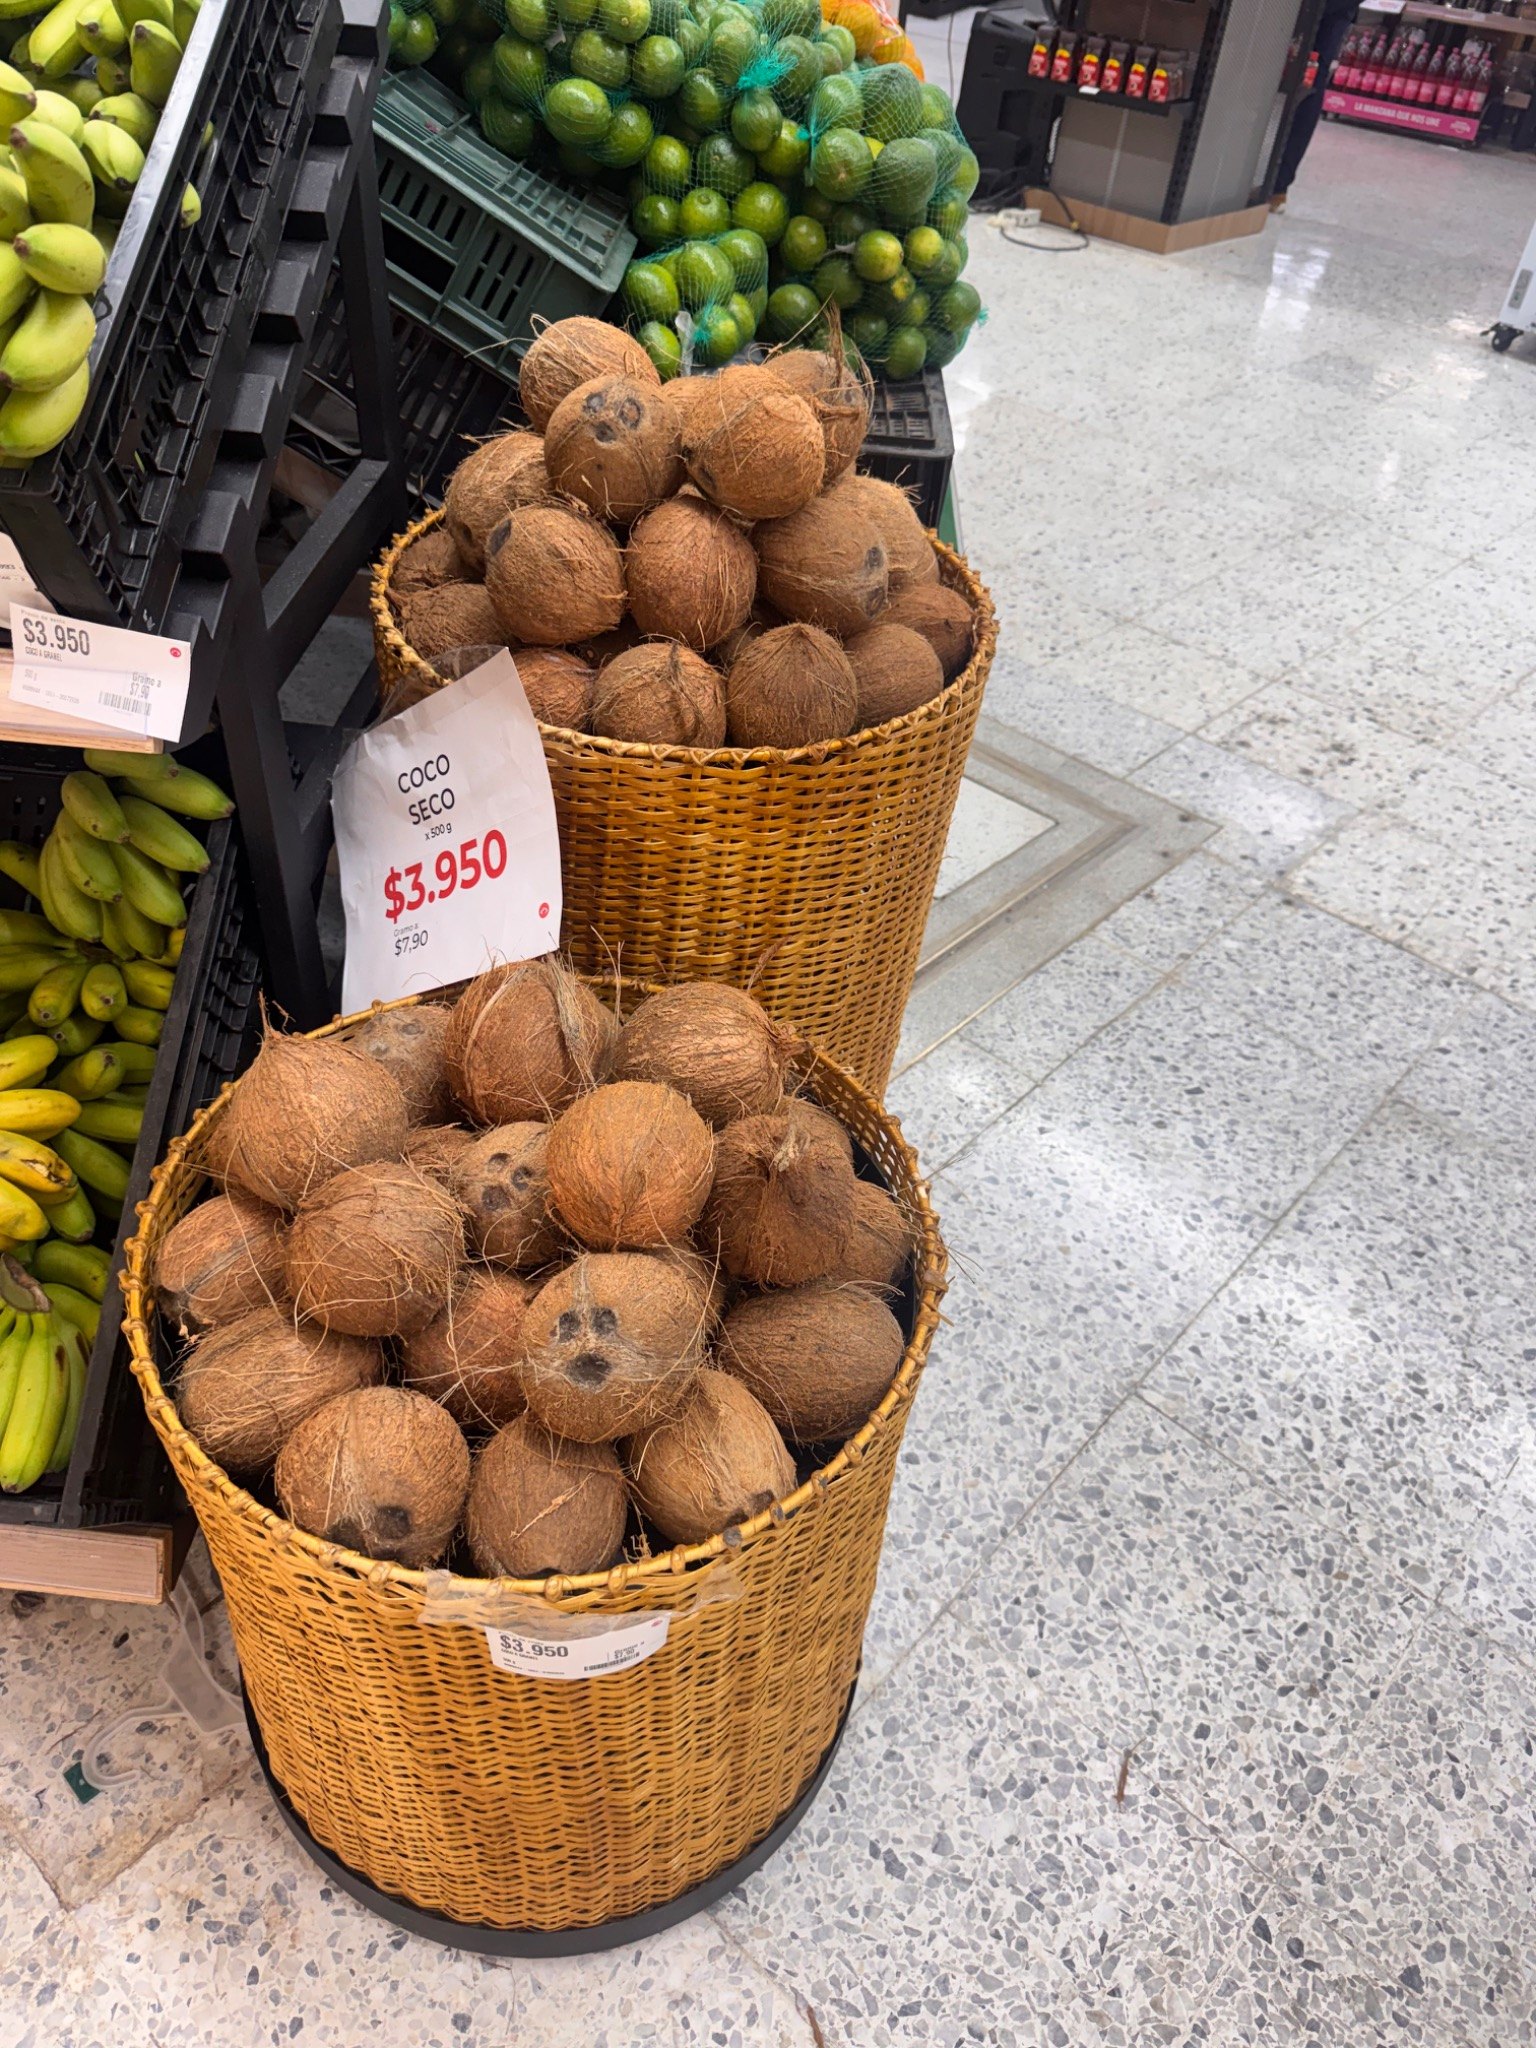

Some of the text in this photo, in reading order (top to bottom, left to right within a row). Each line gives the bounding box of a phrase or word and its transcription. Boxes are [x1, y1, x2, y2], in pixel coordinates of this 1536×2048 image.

[22, 617, 90, 656] $3.950
[398, 754, 450, 794] COCO
[409, 788, 455, 825] SECO
[384, 829, 508, 925] $3.950
[394, 930, 429, 957] $7,90
[500, 1634, 569, 1657] $3.950
